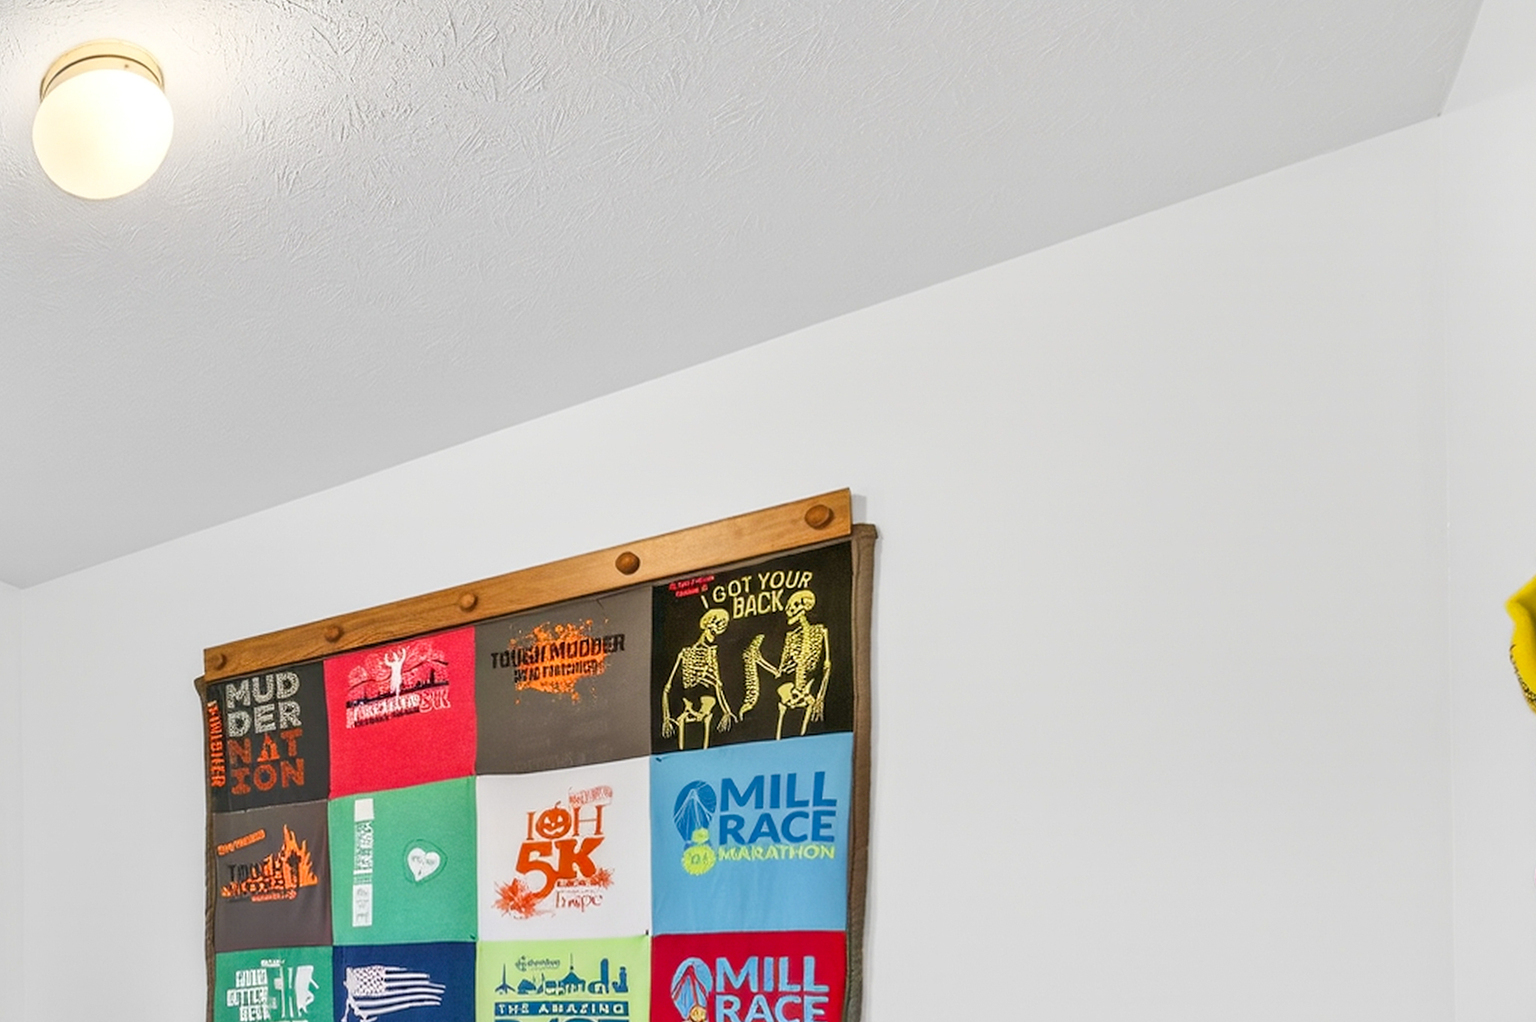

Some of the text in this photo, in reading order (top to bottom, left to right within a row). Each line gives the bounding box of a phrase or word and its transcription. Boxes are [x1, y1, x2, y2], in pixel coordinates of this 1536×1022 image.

[712, 576, 752, 604] GOT
[757, 570, 814, 589] YOUR
[732, 588, 784, 620] BACK
[225, 671, 300, 709] MUD
[227, 701, 302, 737] DER
[720, 771, 837, 812] MILL
[718, 810, 837, 846] RACE
[515, 837, 605, 900] 5K
[717, 843, 836, 862] MARATHON
[715, 955, 830, 992] MILL
[497, 1003, 625, 1015] THE AMAZING
